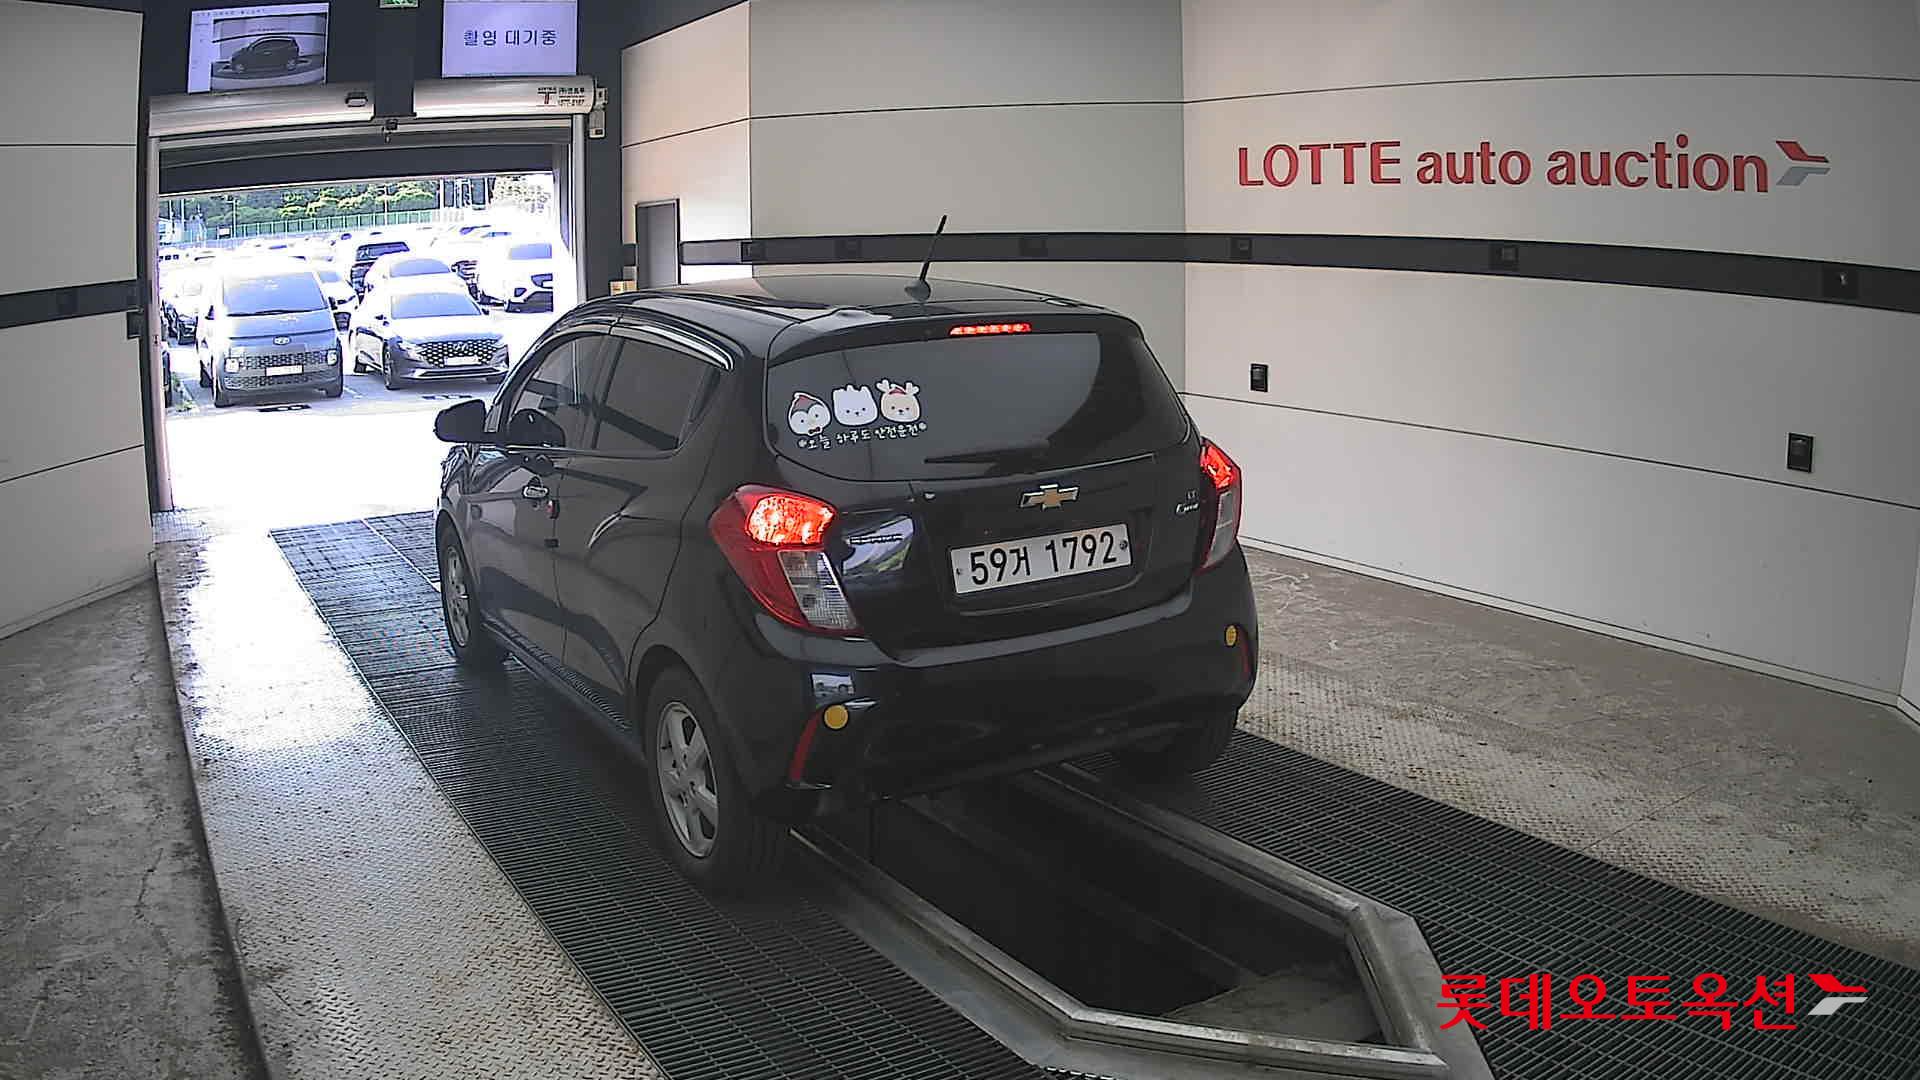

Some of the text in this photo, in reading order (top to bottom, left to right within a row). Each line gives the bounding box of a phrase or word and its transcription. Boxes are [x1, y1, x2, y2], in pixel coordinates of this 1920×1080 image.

[505, 29, 557, 46] 대기중
[1238, 133, 1769, 193] LOTTE auto auction
[807, 422, 919, 449] 오늘 하루도 안전운전
[969, 531, 1117, 586] 59거 1792
